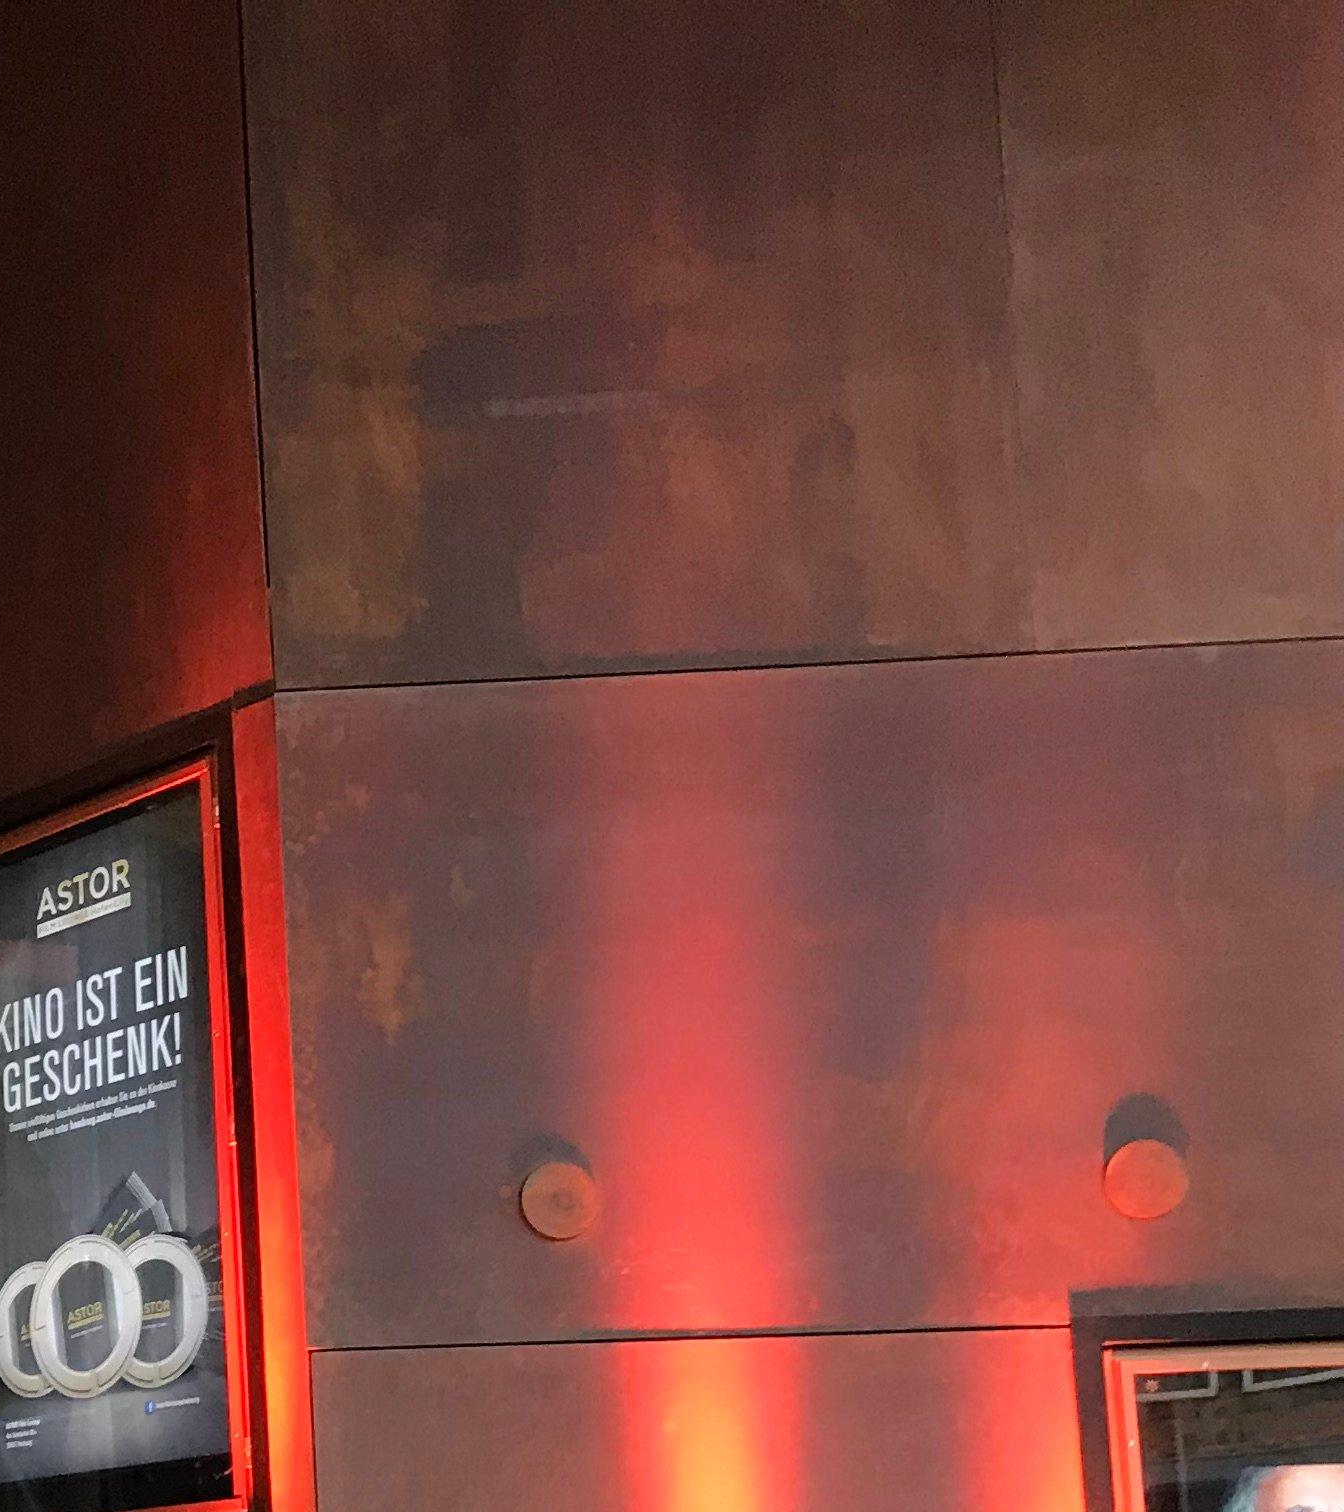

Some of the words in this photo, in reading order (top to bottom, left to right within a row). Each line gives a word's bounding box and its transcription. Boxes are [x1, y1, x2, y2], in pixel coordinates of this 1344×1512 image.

[37, 859, 130, 920] ASTOR
[76, 966, 123, 1031] IST
[134, 946, 188, 1012] EIN
[2, 1012, 182, 1112] GESCHENK!
[68, 1301, 102, 1323] ASTOR
